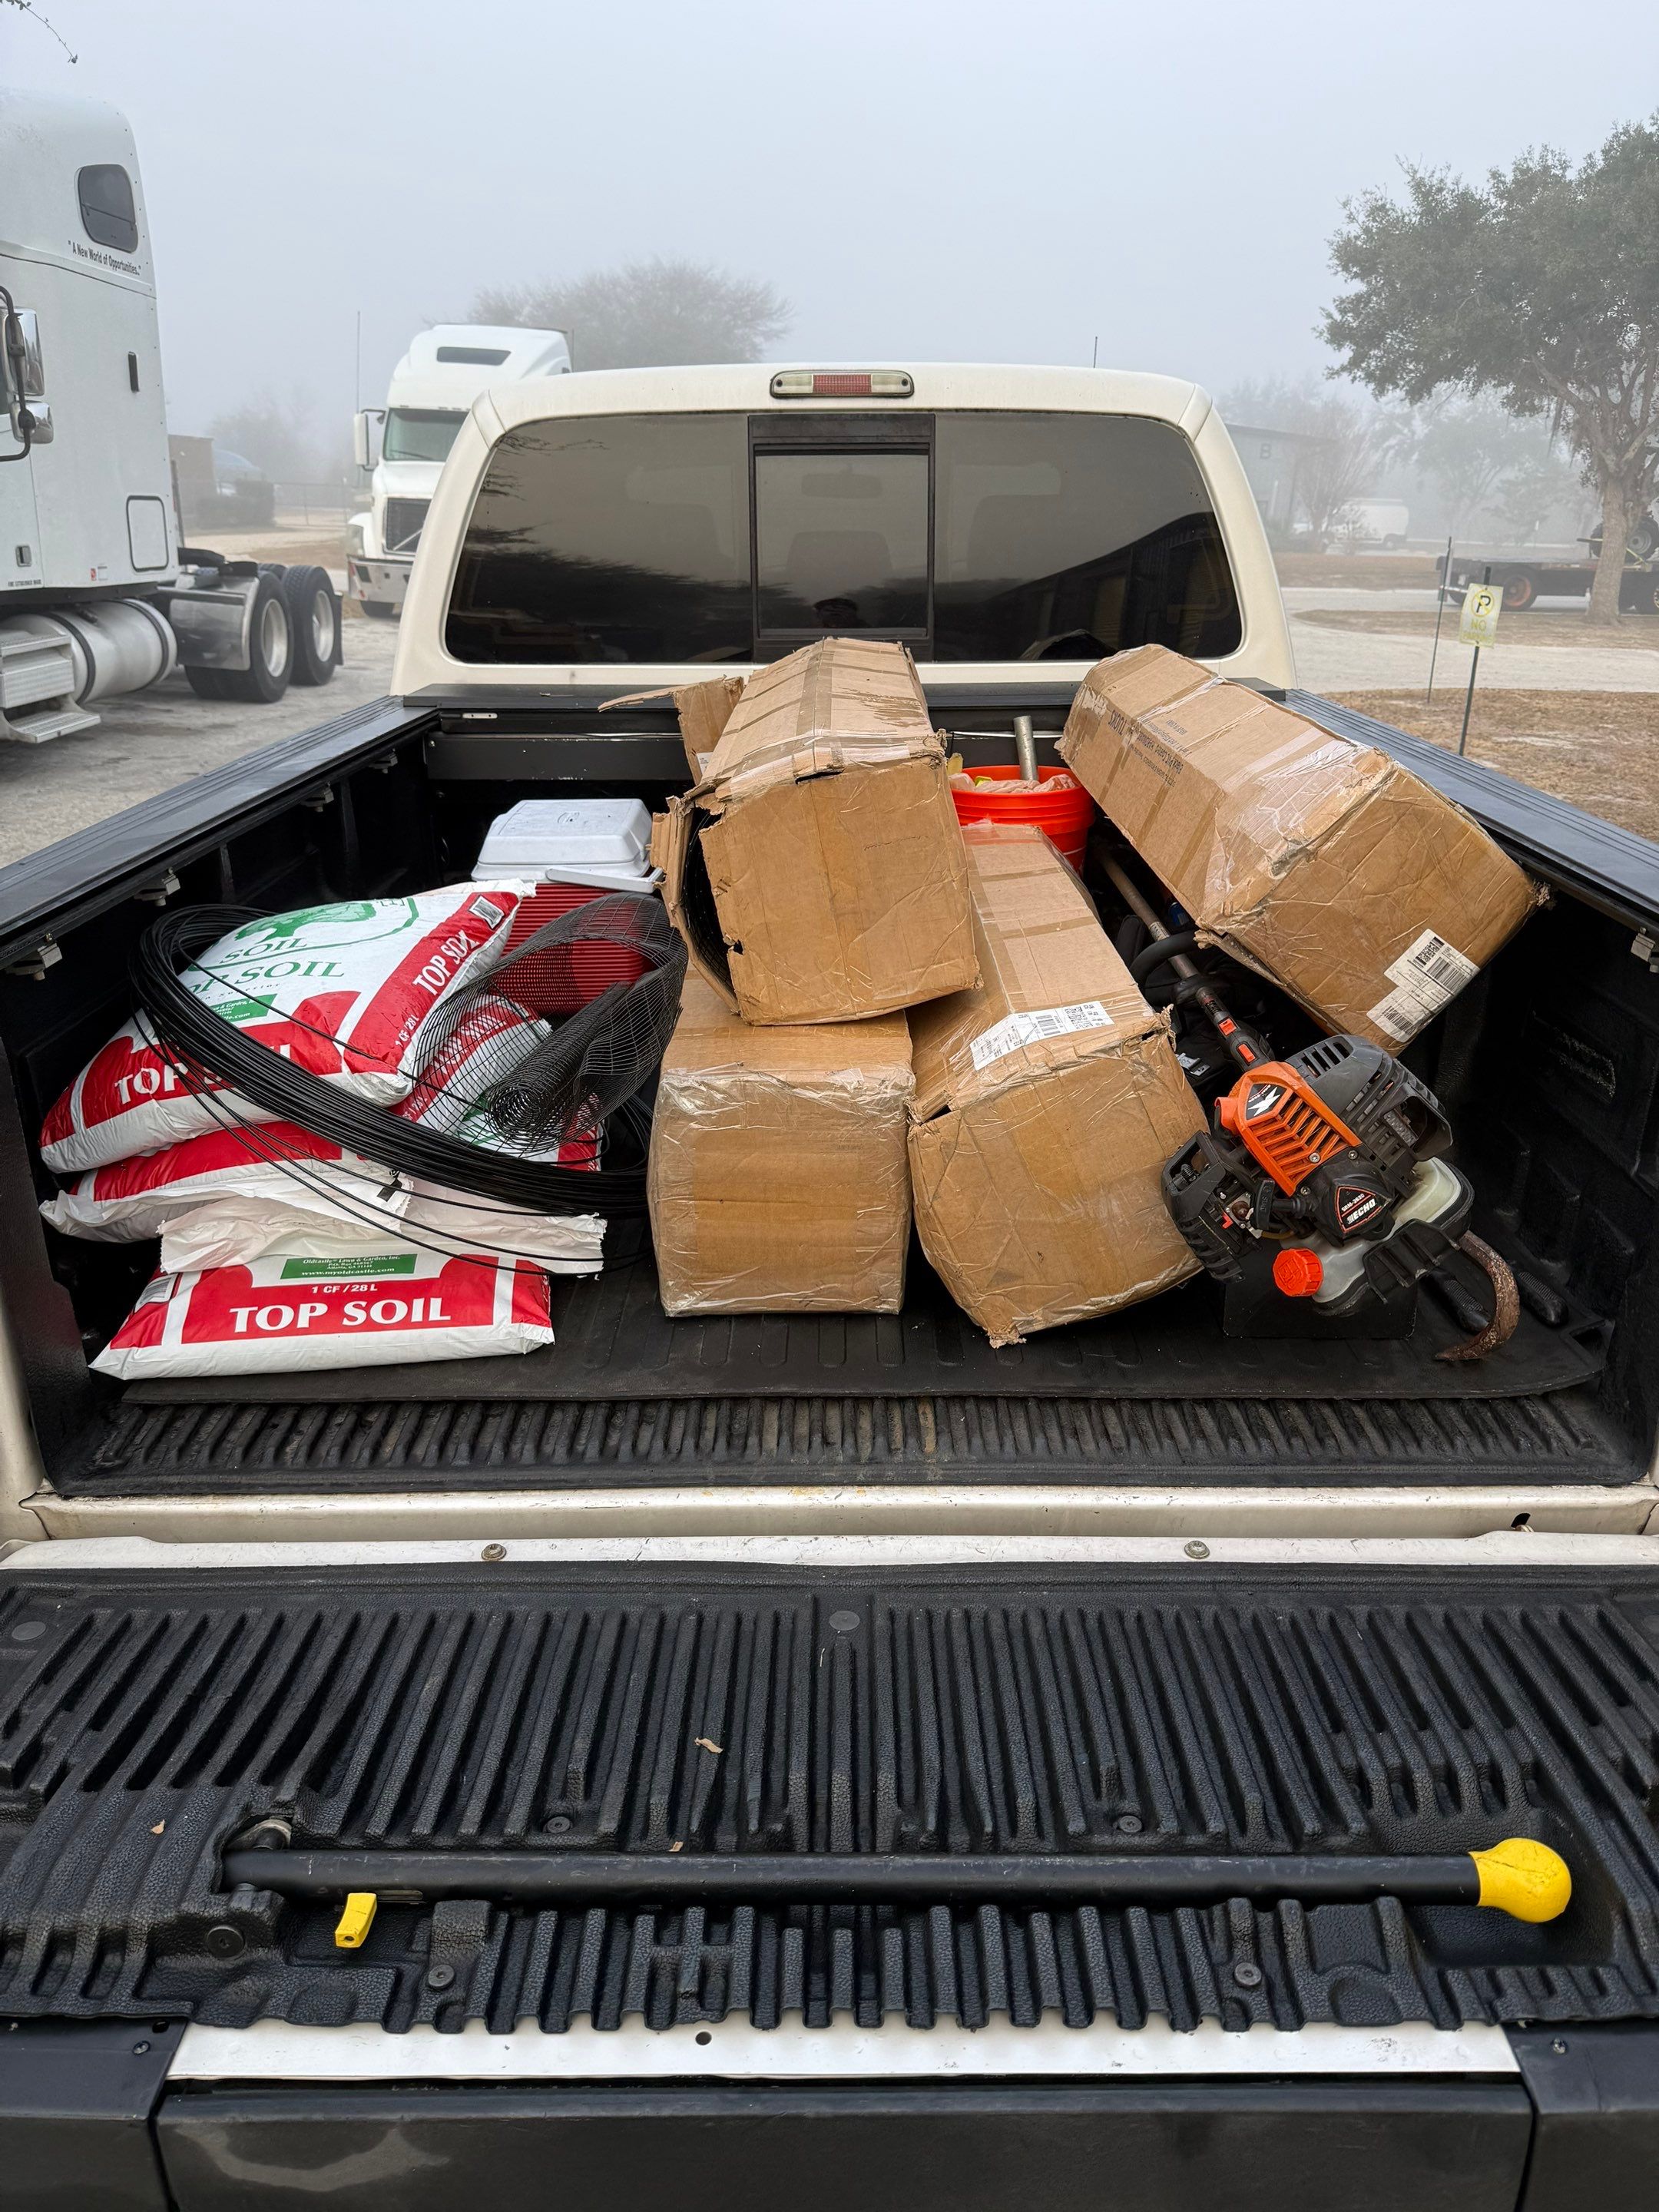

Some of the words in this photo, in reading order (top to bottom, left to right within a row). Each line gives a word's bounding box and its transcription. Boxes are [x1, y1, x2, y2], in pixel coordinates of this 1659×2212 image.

[77, 243, 88, 258] New
[88, 247, 102, 263] World
[103, 253, 108, 265] of
[1471, 618, 1487, 631] NO
[220, 938, 307, 964] SOIL
[235, 961, 345, 985] SOIL
[412, 955, 452, 996] TOP
[114, 1063, 189, 1105] TOP
[1350, 1198, 1376, 1221] ECHO
[301, 1267, 395, 1276] www.myoldcastle.com
[323, 1285, 341, 1293] CF
[230, 1302, 329, 1333] TOP
[342, 1297, 452, 1326] SOIL
